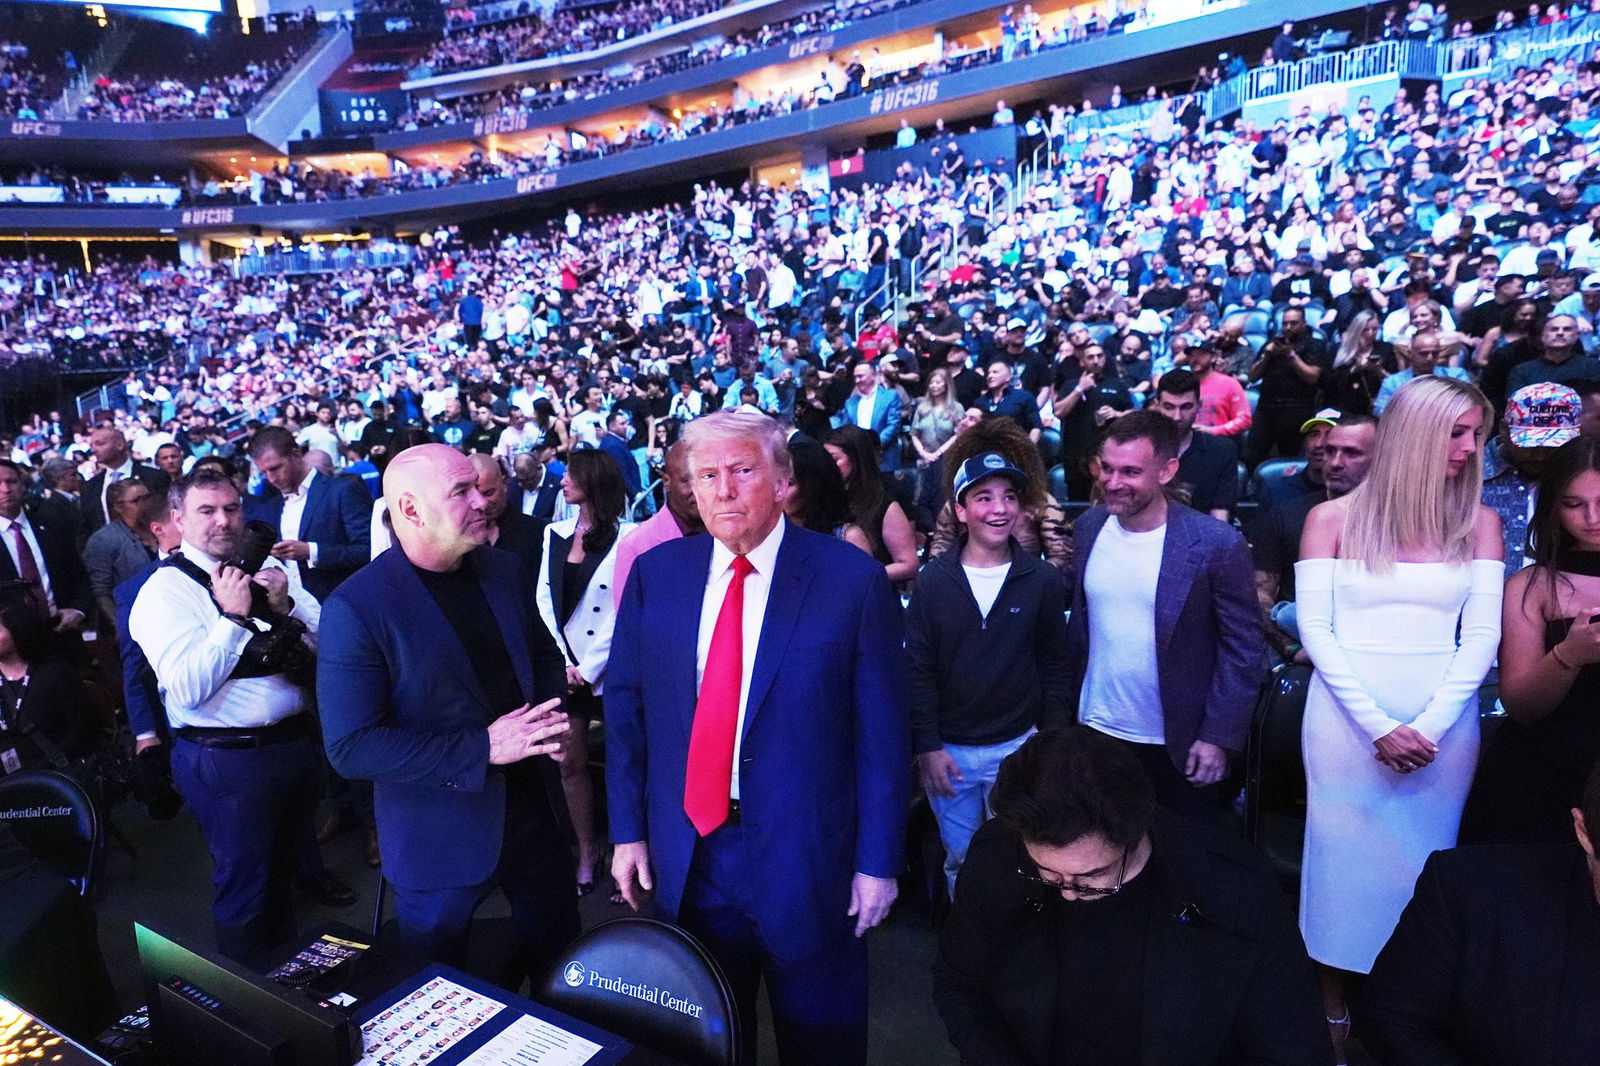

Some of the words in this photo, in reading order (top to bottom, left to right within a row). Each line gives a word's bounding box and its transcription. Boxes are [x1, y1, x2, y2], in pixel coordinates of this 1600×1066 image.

[789, 36, 819, 59] UFC
[870, 81, 939, 115] #UFC316
[341, 109, 387, 122] 1982
[474, 111, 528, 136] #UFC316
[12, 122, 45, 135] UFC
[517, 174, 545, 194] UFC
[182, 208, 234, 224] #UFC316
[0, 806, 41, 819] udential
[42, 805, 73, 817] Center
[587, 970, 659, 1005] Prudential
[660, 990, 703, 1019] Center
